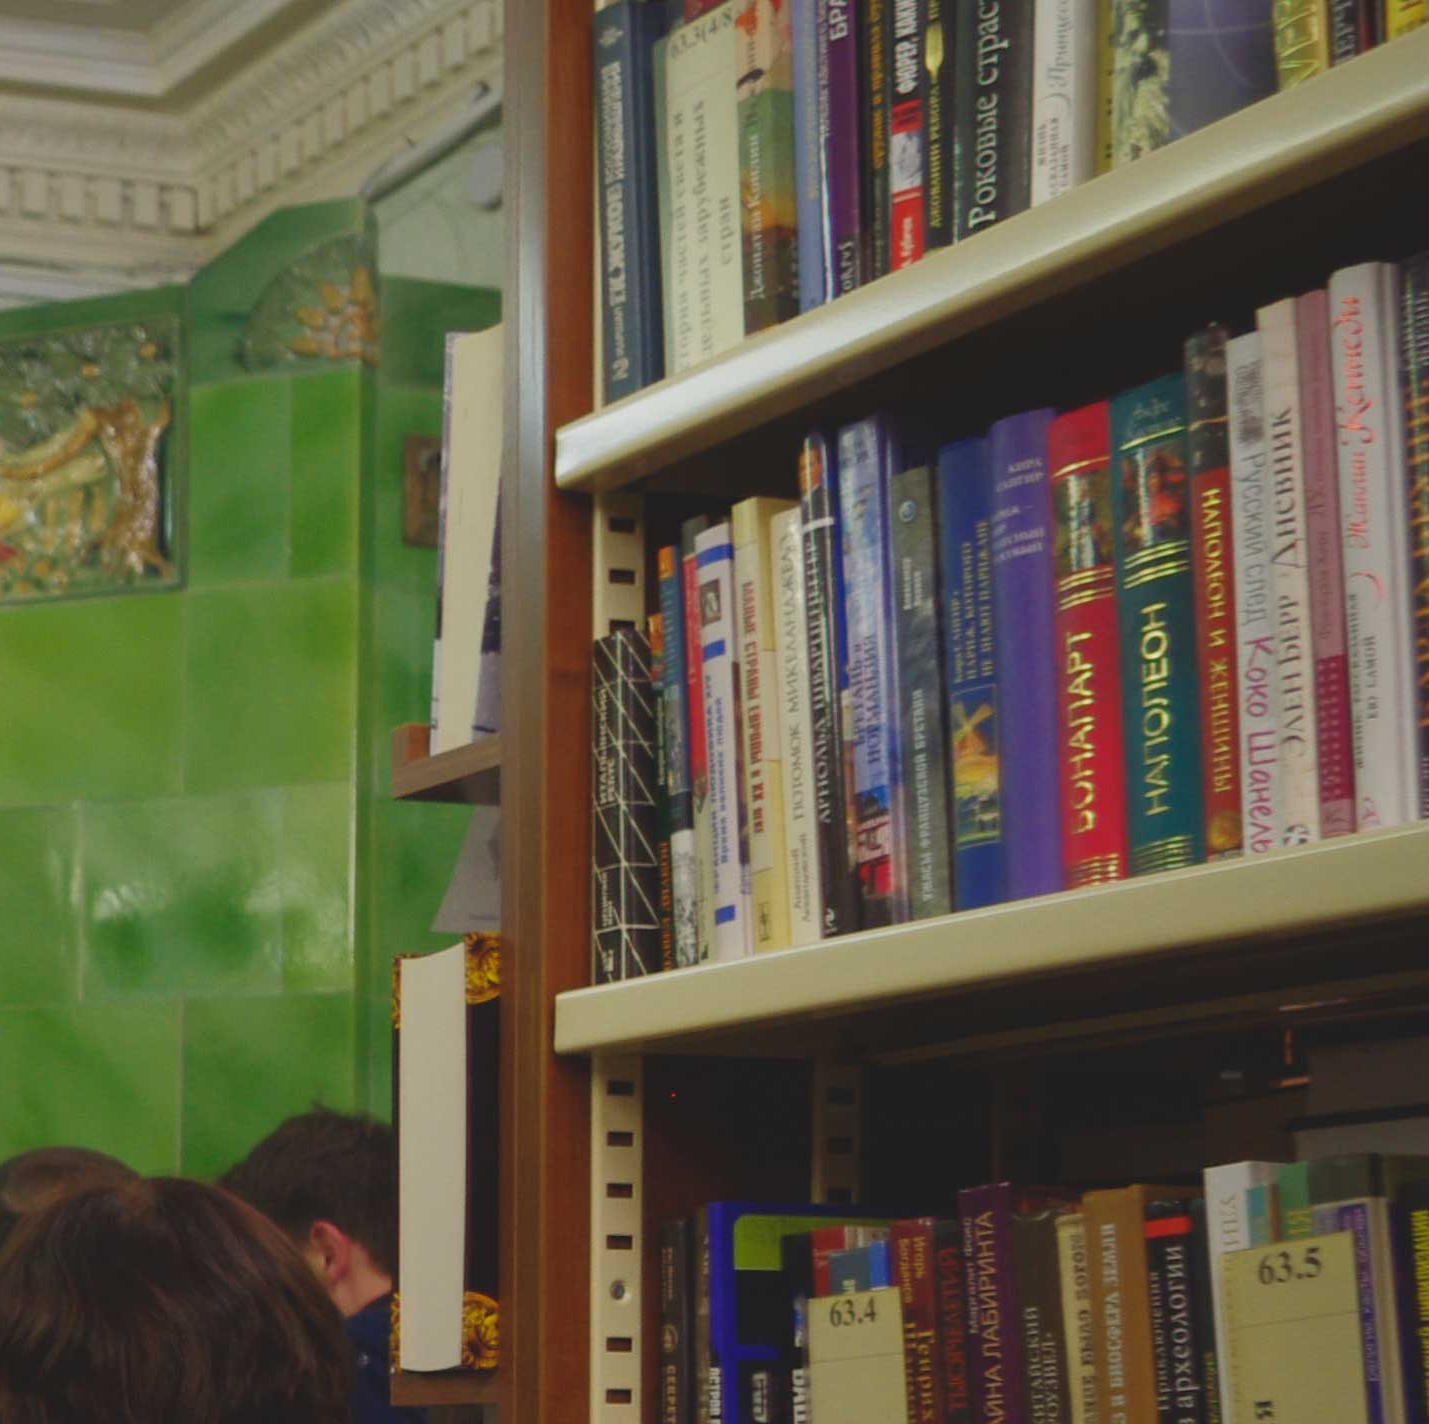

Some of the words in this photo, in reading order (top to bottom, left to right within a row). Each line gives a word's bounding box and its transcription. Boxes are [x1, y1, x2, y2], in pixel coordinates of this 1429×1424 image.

[967, 93, 999, 228] Роковые
[1200, 488, 1226, 621] НАПОЛЕОН
[743, 640, 760, 698] СТРАНЫ
[1208, 629, 1230, 648] И
[1245, 637, 1277, 718] Коко
[746, 704, 762, 763] ЕВРОПЫ
[1066, 631, 1096, 832] БОНАПАРТ
[1139, 602, 1172, 814] НАПОЛЕОН
[1208, 658, 1236, 794] ЖЕНЩИНЫ
[786, 721, 804, 821] ПОТОМОК
[811, 718, 831, 824] АРНОЛЬД
[1248, 731, 1279, 852] Шанель
[975, 1209, 1003, 1358] ЛАБИРИНТА
[1099, 1222, 1118, 1284] ЗЕМЛИ
[1258, 1246, 1323, 1286] 63.5
[829, 1296, 877, 1328] 63.4
[1104, 1291, 1124, 1388] БИОСФЕРА
[1165, 1246, 1202, 1408] археологии
